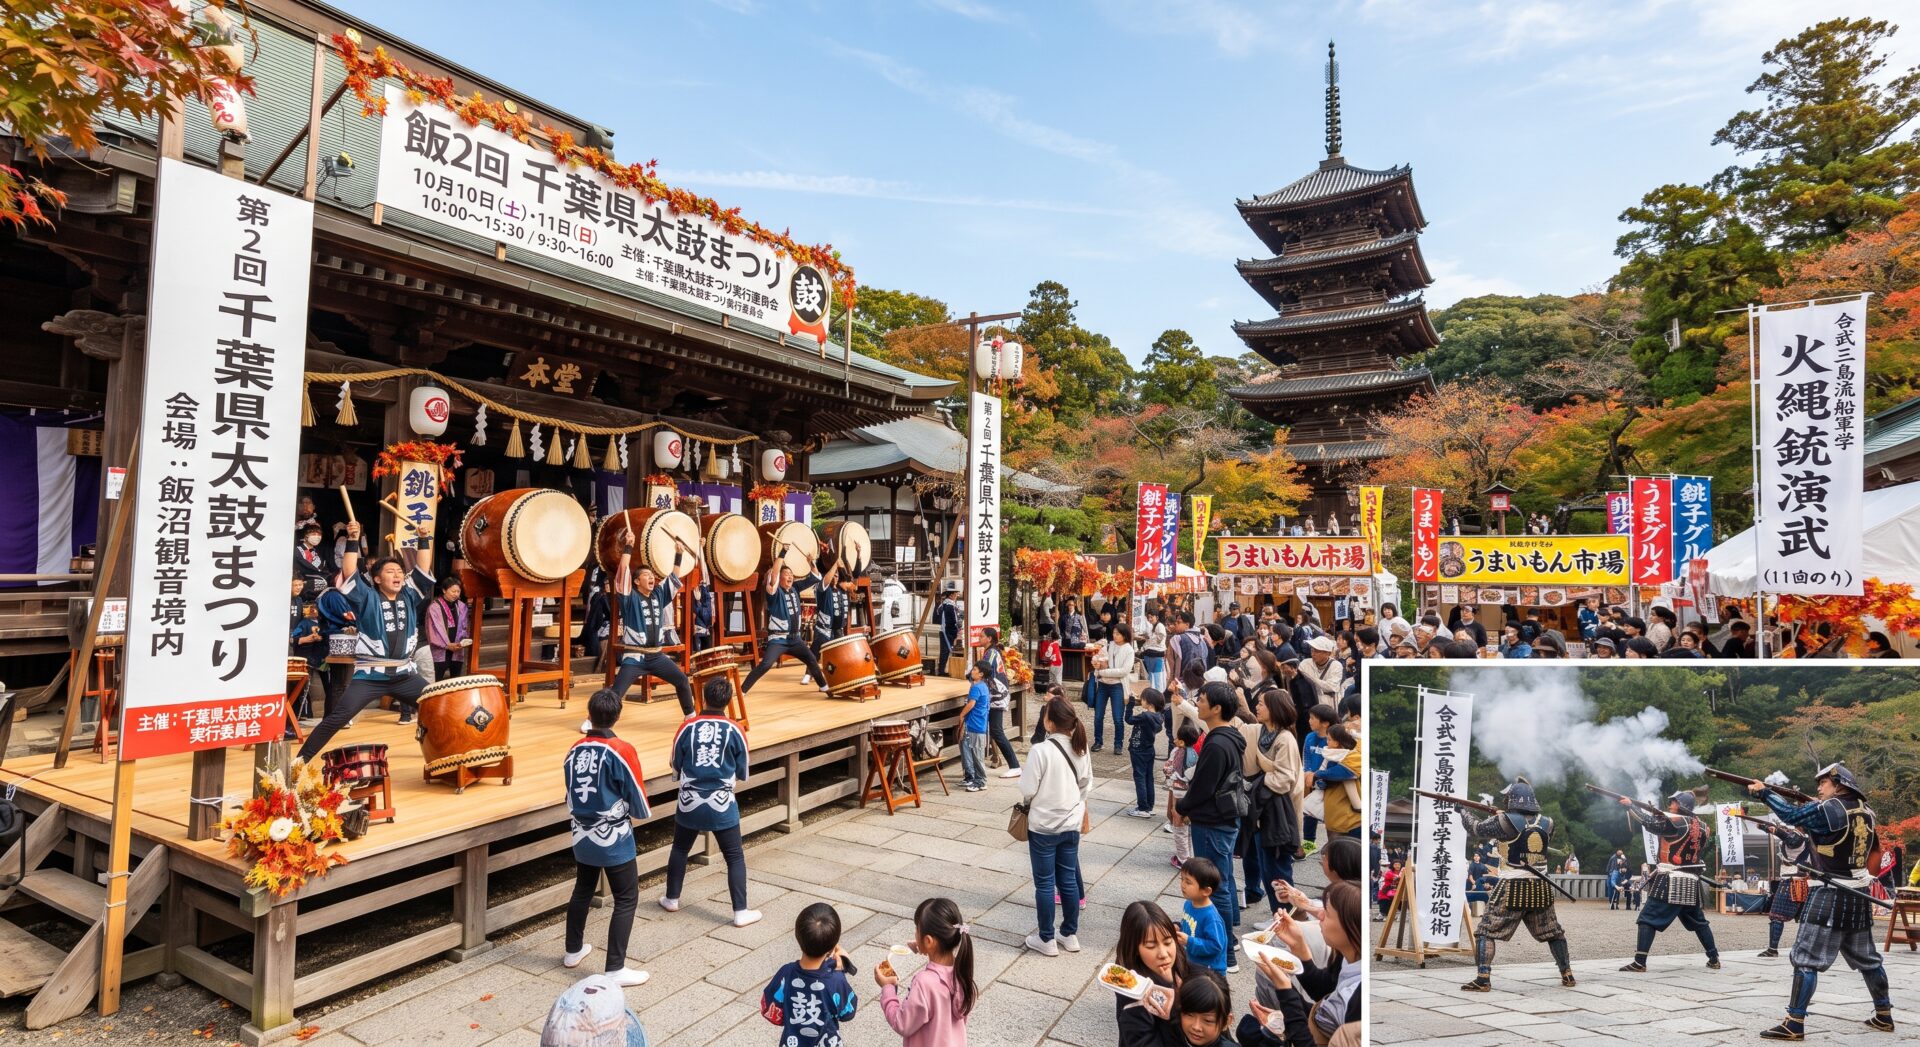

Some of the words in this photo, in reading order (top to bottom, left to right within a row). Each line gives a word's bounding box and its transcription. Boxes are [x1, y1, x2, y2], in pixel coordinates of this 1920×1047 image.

[233, 194, 271, 287] 第2回
[404, 109, 511, 189] 飯2回
[522, 158, 781, 289] 千葉県太鼓まつり
[794, 274, 824, 316] 鼓
[520, 357, 582, 394] 本堂
[983, 401, 993, 441] 第2回
[1774, 334, 1833, 560] 火縄銃演武
[151, 392, 200, 657] 会場：飯沼観音境内
[204, 291, 277, 682] 千葉県太鼓まつり
[977, 444, 996, 618] 千葉県太鼓まつり
[1138, 489, 1163, 573] 銚子グルメ
[1225, 543, 1366, 571] うまいもん市場
[1416, 493, 1436, 577] うまいもん
[1468, 549, 1625, 575] うまいもん市場
[1638, 483, 1667, 579] うまグルメ
[190, 720, 261, 744] 実行委員会
[789, 992, 825, 1026] 鼓
